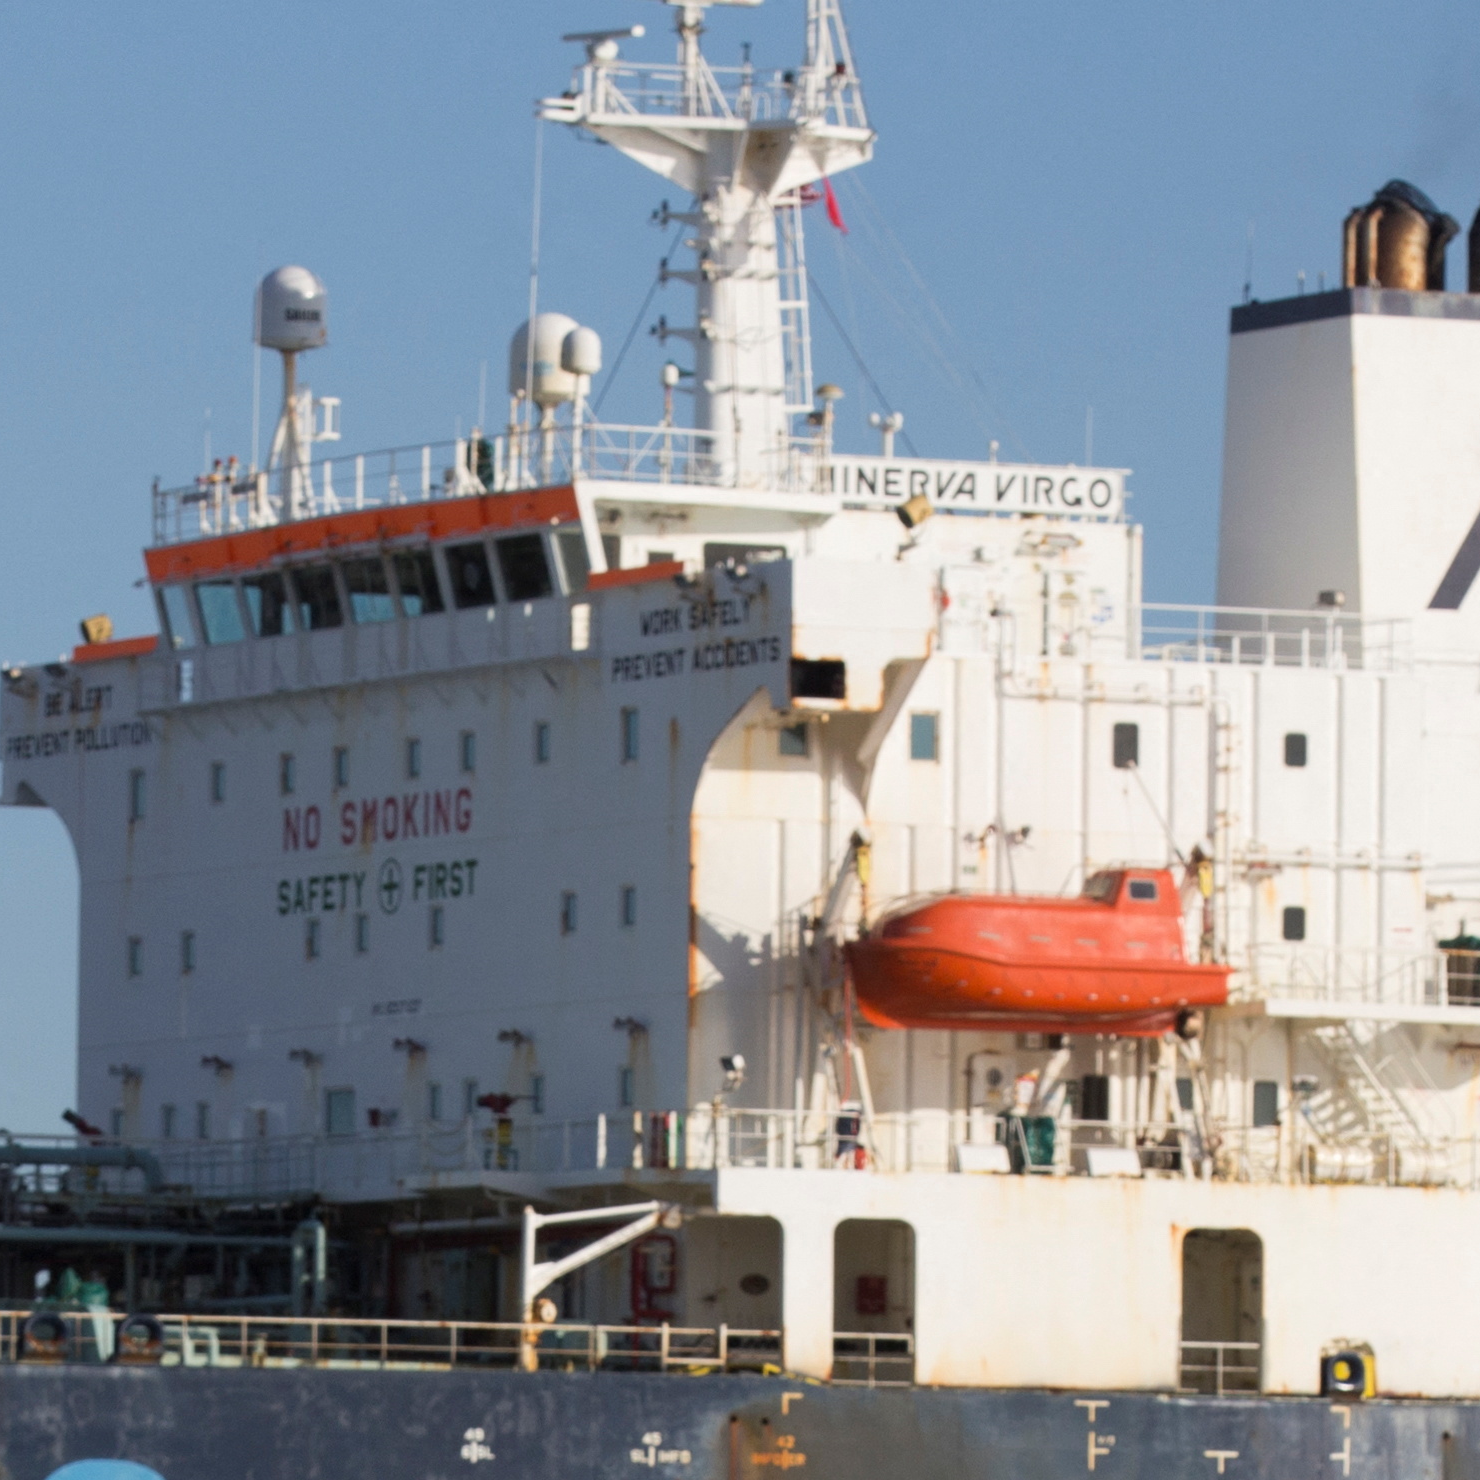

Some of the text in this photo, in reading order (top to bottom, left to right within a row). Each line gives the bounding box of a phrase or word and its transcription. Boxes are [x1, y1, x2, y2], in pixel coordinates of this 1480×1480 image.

[995, 473, 1113, 510] VIRGO
[640, 599, 752, 638] WORK SAFELY
[611, 636, 781, 683] PREVENT ACCIDENTS
[282, 787, 473, 851] NO SMOKING
[277, 859, 479, 916] SAFETY FIRST
